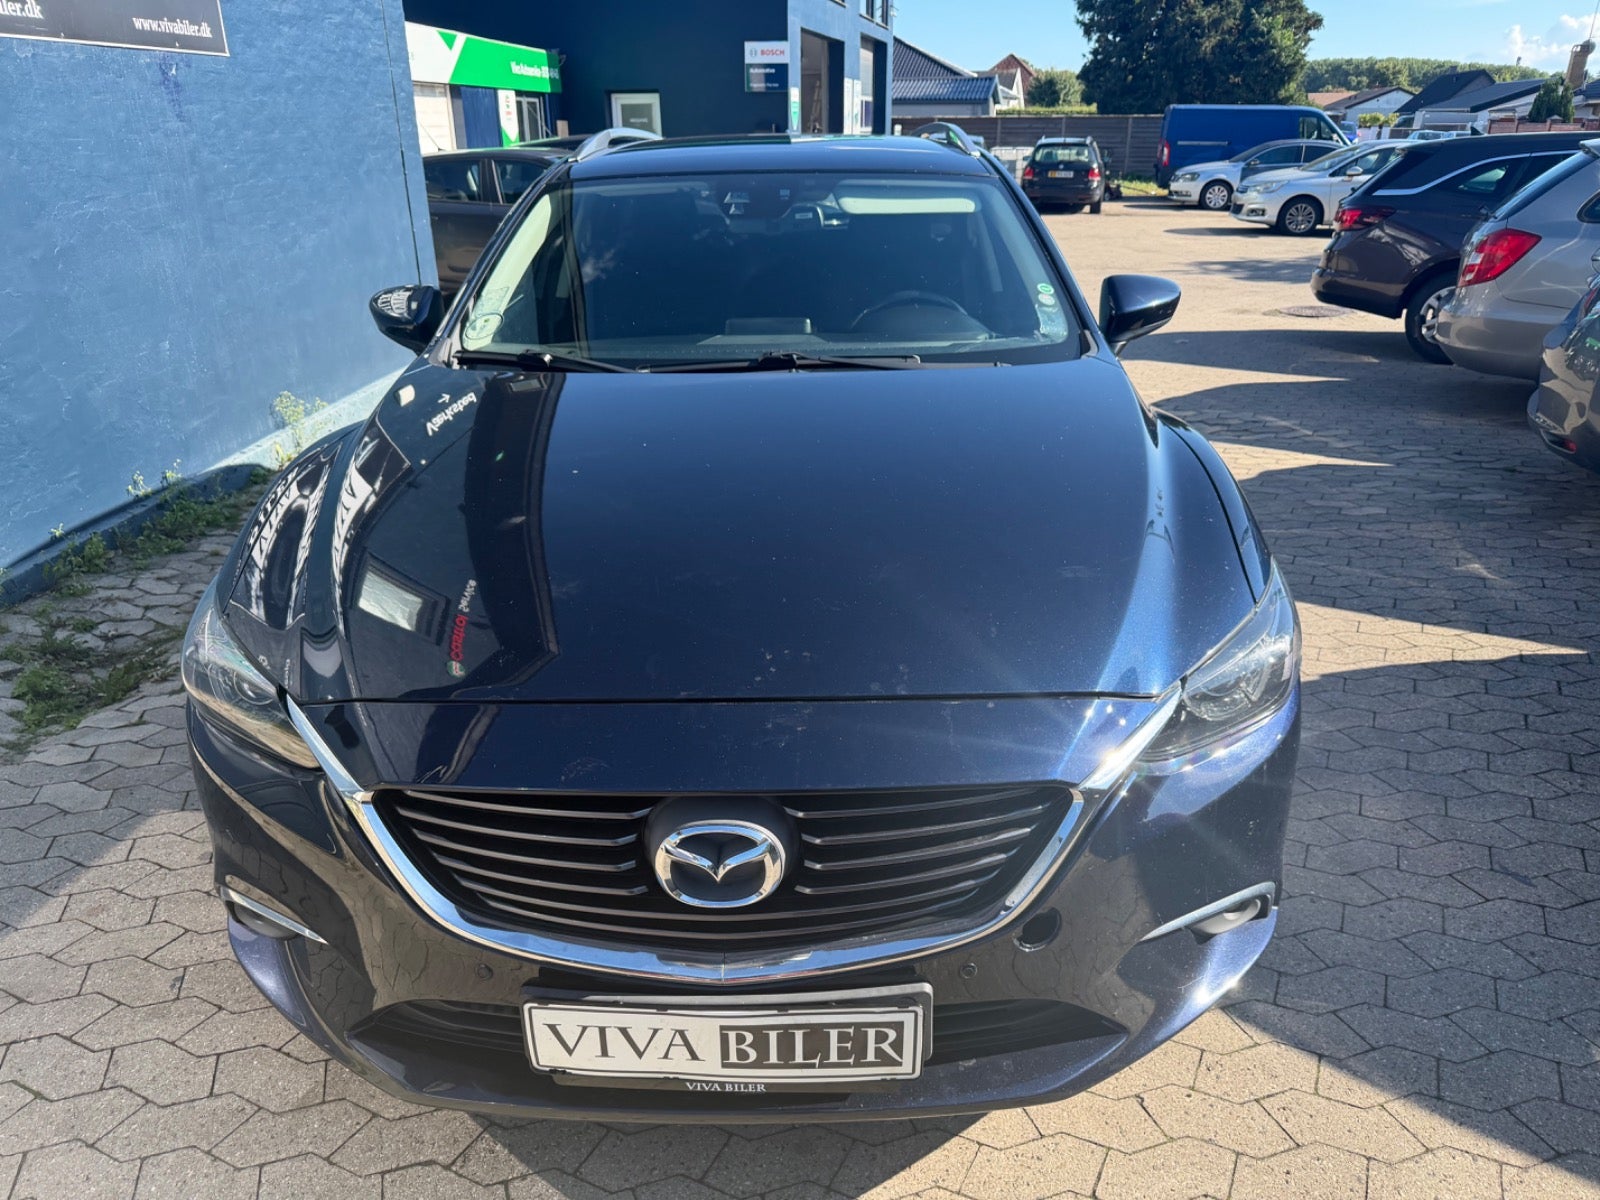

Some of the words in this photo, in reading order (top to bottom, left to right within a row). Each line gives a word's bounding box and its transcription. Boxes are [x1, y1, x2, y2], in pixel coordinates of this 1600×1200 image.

[132, 17, 213, 38] www.vivabiler.dk
[542, 1022, 706, 1062] VIVA
[721, 1026, 904, 1069] BILER
[685, 1081, 721, 1092] VIVA
[724, 1082, 767, 1093] BILER
